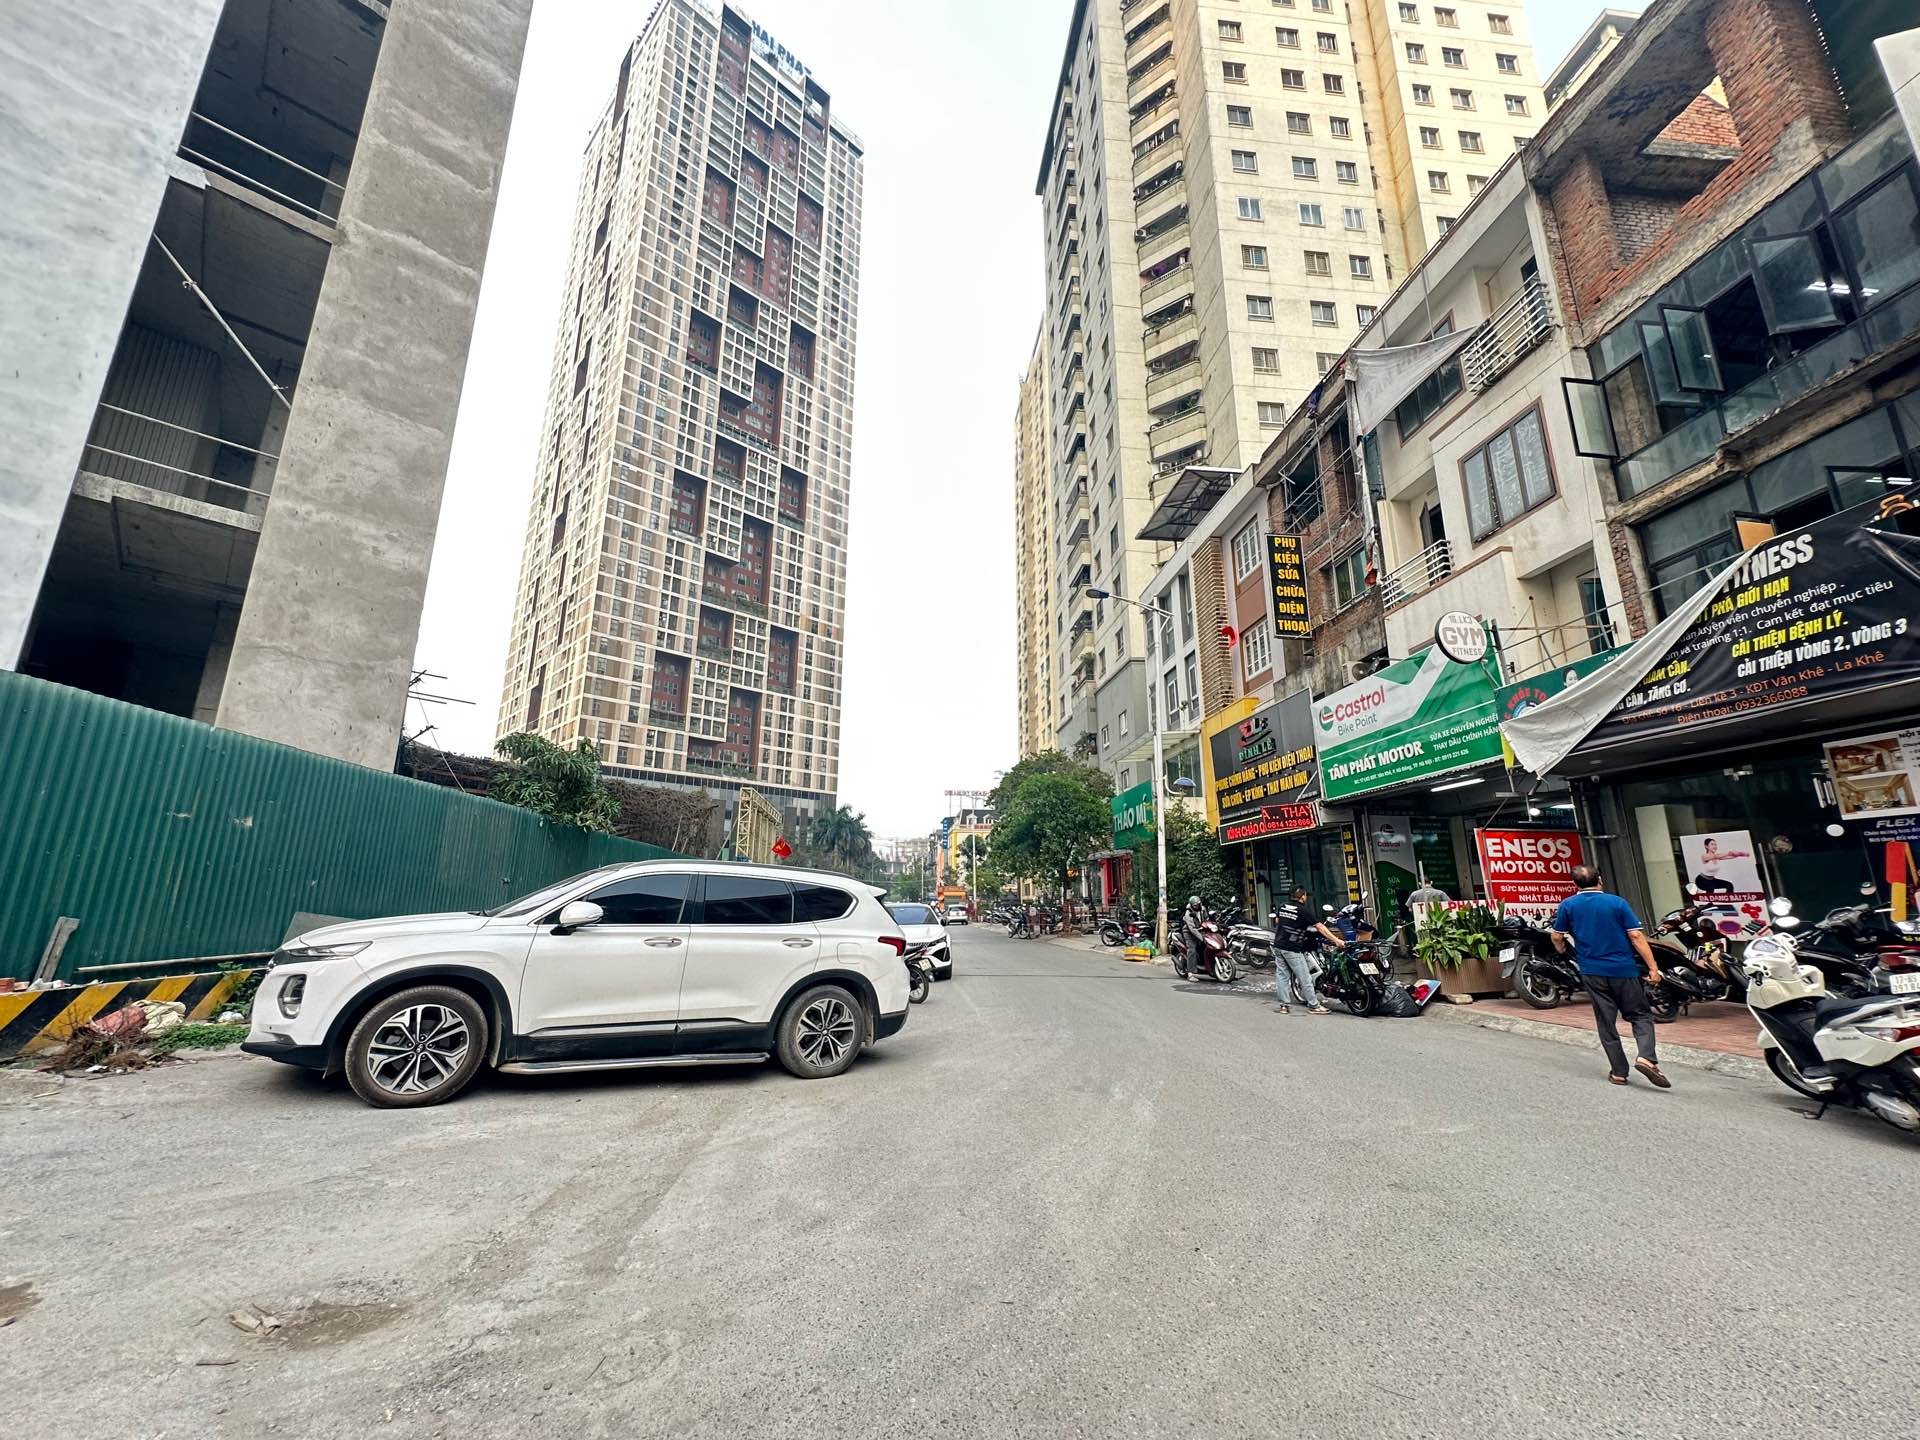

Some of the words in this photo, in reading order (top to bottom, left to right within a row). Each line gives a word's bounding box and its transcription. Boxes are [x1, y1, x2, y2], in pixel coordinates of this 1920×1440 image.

[1274, 537, 1296, 551] PHỤ
[1274, 552, 1300, 565] KIỆN
[1278, 564, 1300, 580] SỬA
[1276, 584, 1305, 598] CHỮA
[1737, 584, 1761, 608] GIỚI
[1763, 576, 1790, 599] HẠN
[1279, 601, 1304, 616] ĐIỆN
[1691, 631, 1732, 653] training
[1756, 615, 1783, 631] Cam
[1785, 607, 1805, 622] kết
[1809, 599, 1831, 614] đạt
[1833, 590, 1863, 607] mục
[1865, 580, 1894, 596] tiêu
[1698, 618, 1726, 640] luyện
[1725, 611, 1749, 627] viên
[1751, 596, 1792, 621] chuyên
[1794, 582, 1837, 604] nghiệp
[1277, 619, 1310, 634] THOẠI
[1441, 627, 1485, 646] GYM
[1732, 638, 1751, 658] CẢI
[1753, 629, 1786, 652] THIỆN
[1789, 617, 1823, 640] BỆNH
[1452, 647, 1483, 656] FITNESS
[1737, 658, 1757, 678] CẢI
[1759, 649, 1792, 672] THIỆN
[1795, 638, 1831, 662] VÒNG
[1851, 622, 1892, 647] VÒNG
[1894, 618, 1908, 635] 3
[1729, 690, 1738, 700] 3
[1745, 681, 1769, 696] KĐT
[1771, 673, 1797, 688] Văn
[1799, 666, 1825, 682] Khê
[1835, 658, 1853, 672] La
[1855, 651, 1886, 667] Khê
[1648, 684, 1672, 704] TĂNG
[1735, 686, 1808, 711] 0932366088
[1335, 686, 1385, 721] Castrol
[1338, 719, 1355, 736] Bike
[1355, 714, 1377, 730] Point
[1442, 728, 1451, 737] XE
[1450, 721, 1475, 735] CHUYÊN
[1433, 741, 1448, 751] THAY
[1448, 735, 1462, 747] DẦU
[1462, 731, 1483, 742] CHÍNH
[1328, 761, 1349, 781] TÂN
[1350, 752, 1377, 775] PHÁT
[1379, 741, 1424, 768] MOTOR
[1281, 805, 1311, 819] THAY
[1241, 822, 1259, 837] CHÀO
[1285, 819, 1297, 827] 123
[1876, 817, 1916, 828] FLEX
[1485, 837, 1572, 859] ENEOS
[1490, 860, 1547, 874] MOTOR
[1501, 883, 1517, 893] SỨC
[1518, 885, 1539, 894] MẠNH
[1540, 883, 1556, 893] DẦU
[1519, 893, 1543, 902] NHẬT
[1544, 893, 1562, 902] BẢN
